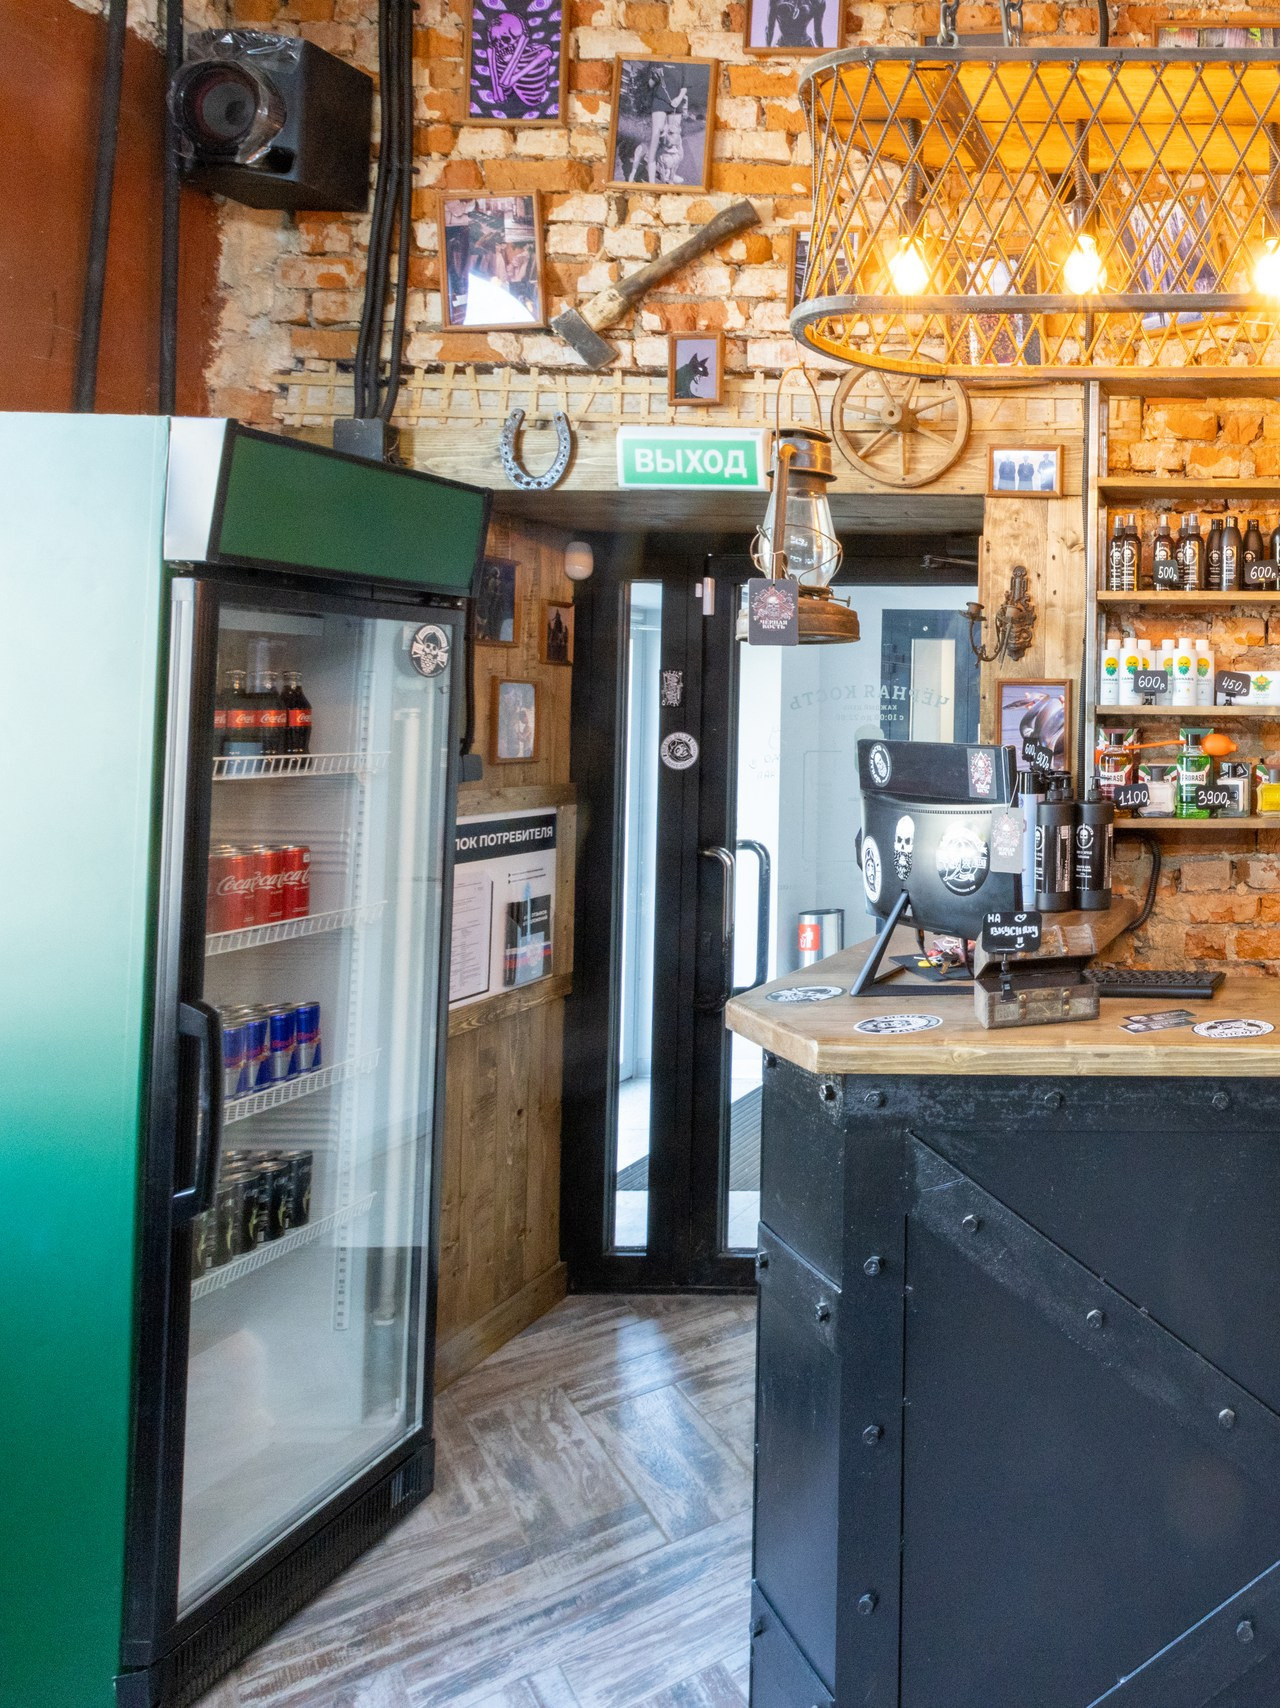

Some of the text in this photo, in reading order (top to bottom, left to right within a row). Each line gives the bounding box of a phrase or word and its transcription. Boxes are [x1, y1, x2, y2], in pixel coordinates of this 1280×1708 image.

[635, 448, 748, 478] ВЫХОД
[480, 826, 553, 847] ПОТРЕБИТЕЛЯ
[988, 913, 1001, 923] НА
